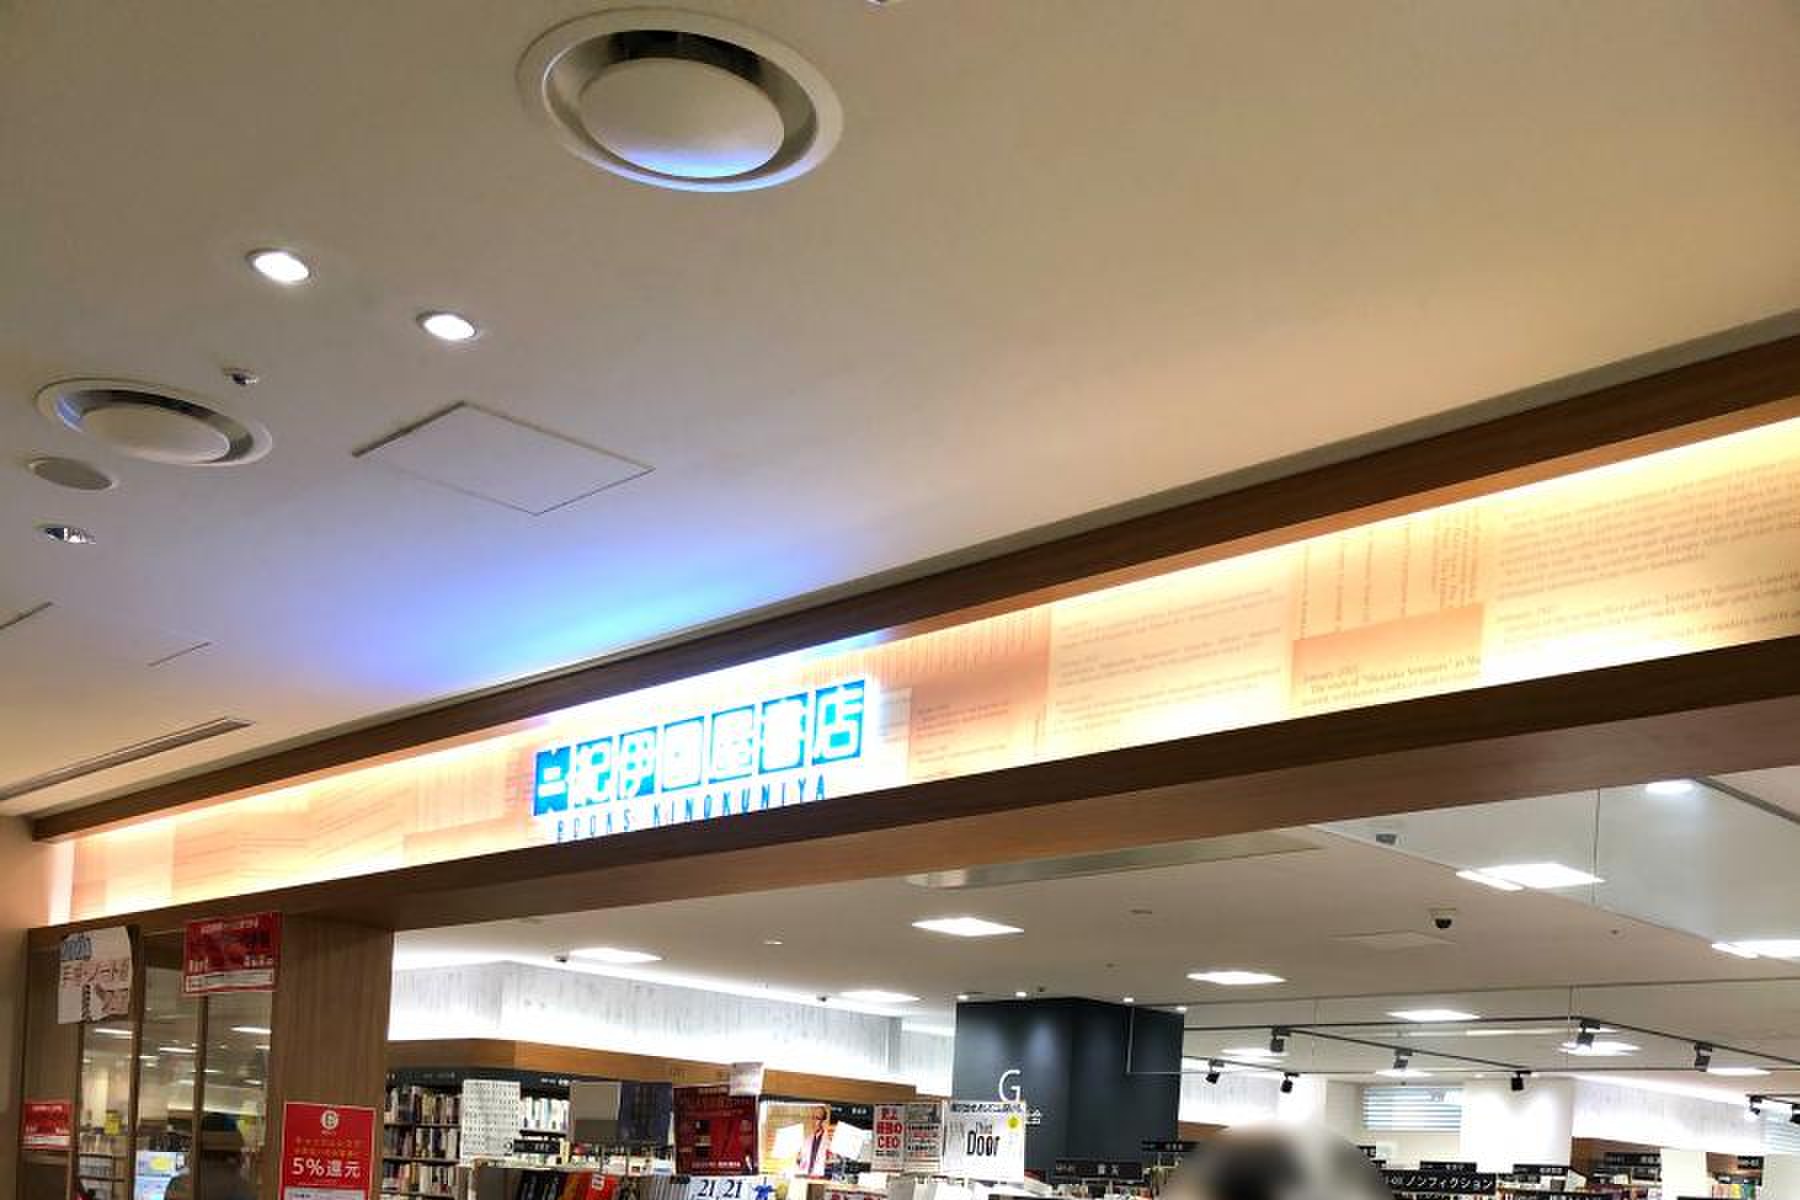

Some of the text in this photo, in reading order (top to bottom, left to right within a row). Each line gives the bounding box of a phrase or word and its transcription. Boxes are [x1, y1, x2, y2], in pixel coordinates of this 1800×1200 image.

[653, 774, 826, 831] KINOKUNIYA
[998, 1068, 1021, 1103] G
[878, 1135, 900, 1149] CEO
[966, 1129, 1001, 1157] Door
[291, 1157, 361, 1178] 5%還元
[697, 1178, 716, 1198] 21
[723, 1179, 744, 1199] 21
[1405, 1175, 1493, 1190] ノンフィクション
